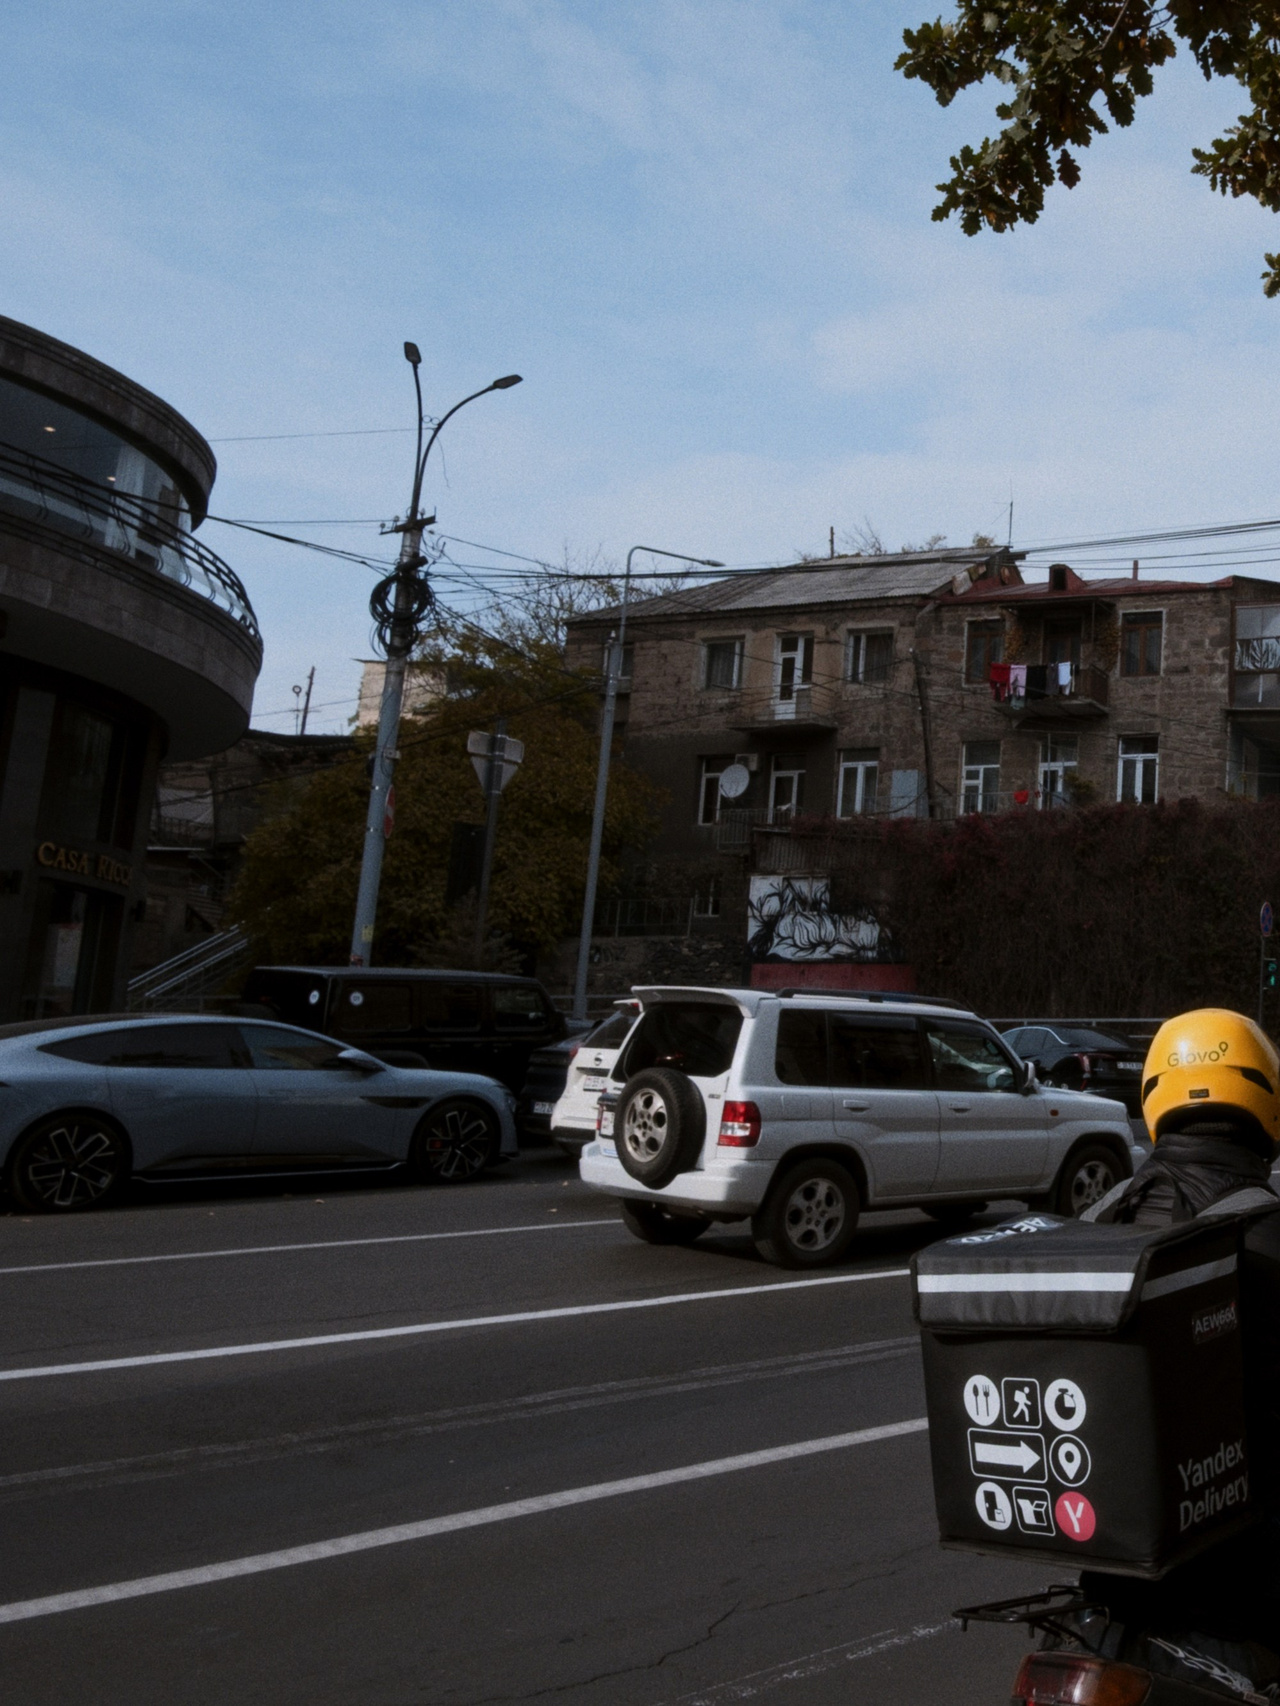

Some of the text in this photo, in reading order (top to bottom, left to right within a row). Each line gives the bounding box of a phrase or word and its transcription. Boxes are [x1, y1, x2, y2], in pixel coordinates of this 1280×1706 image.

[37, 841, 90, 875] CASA
[1177, 1438, 1244, 1492] Yandex
[1063, 1500, 1084, 1533] Y
[1179, 1471, 1249, 1532] Delivery
